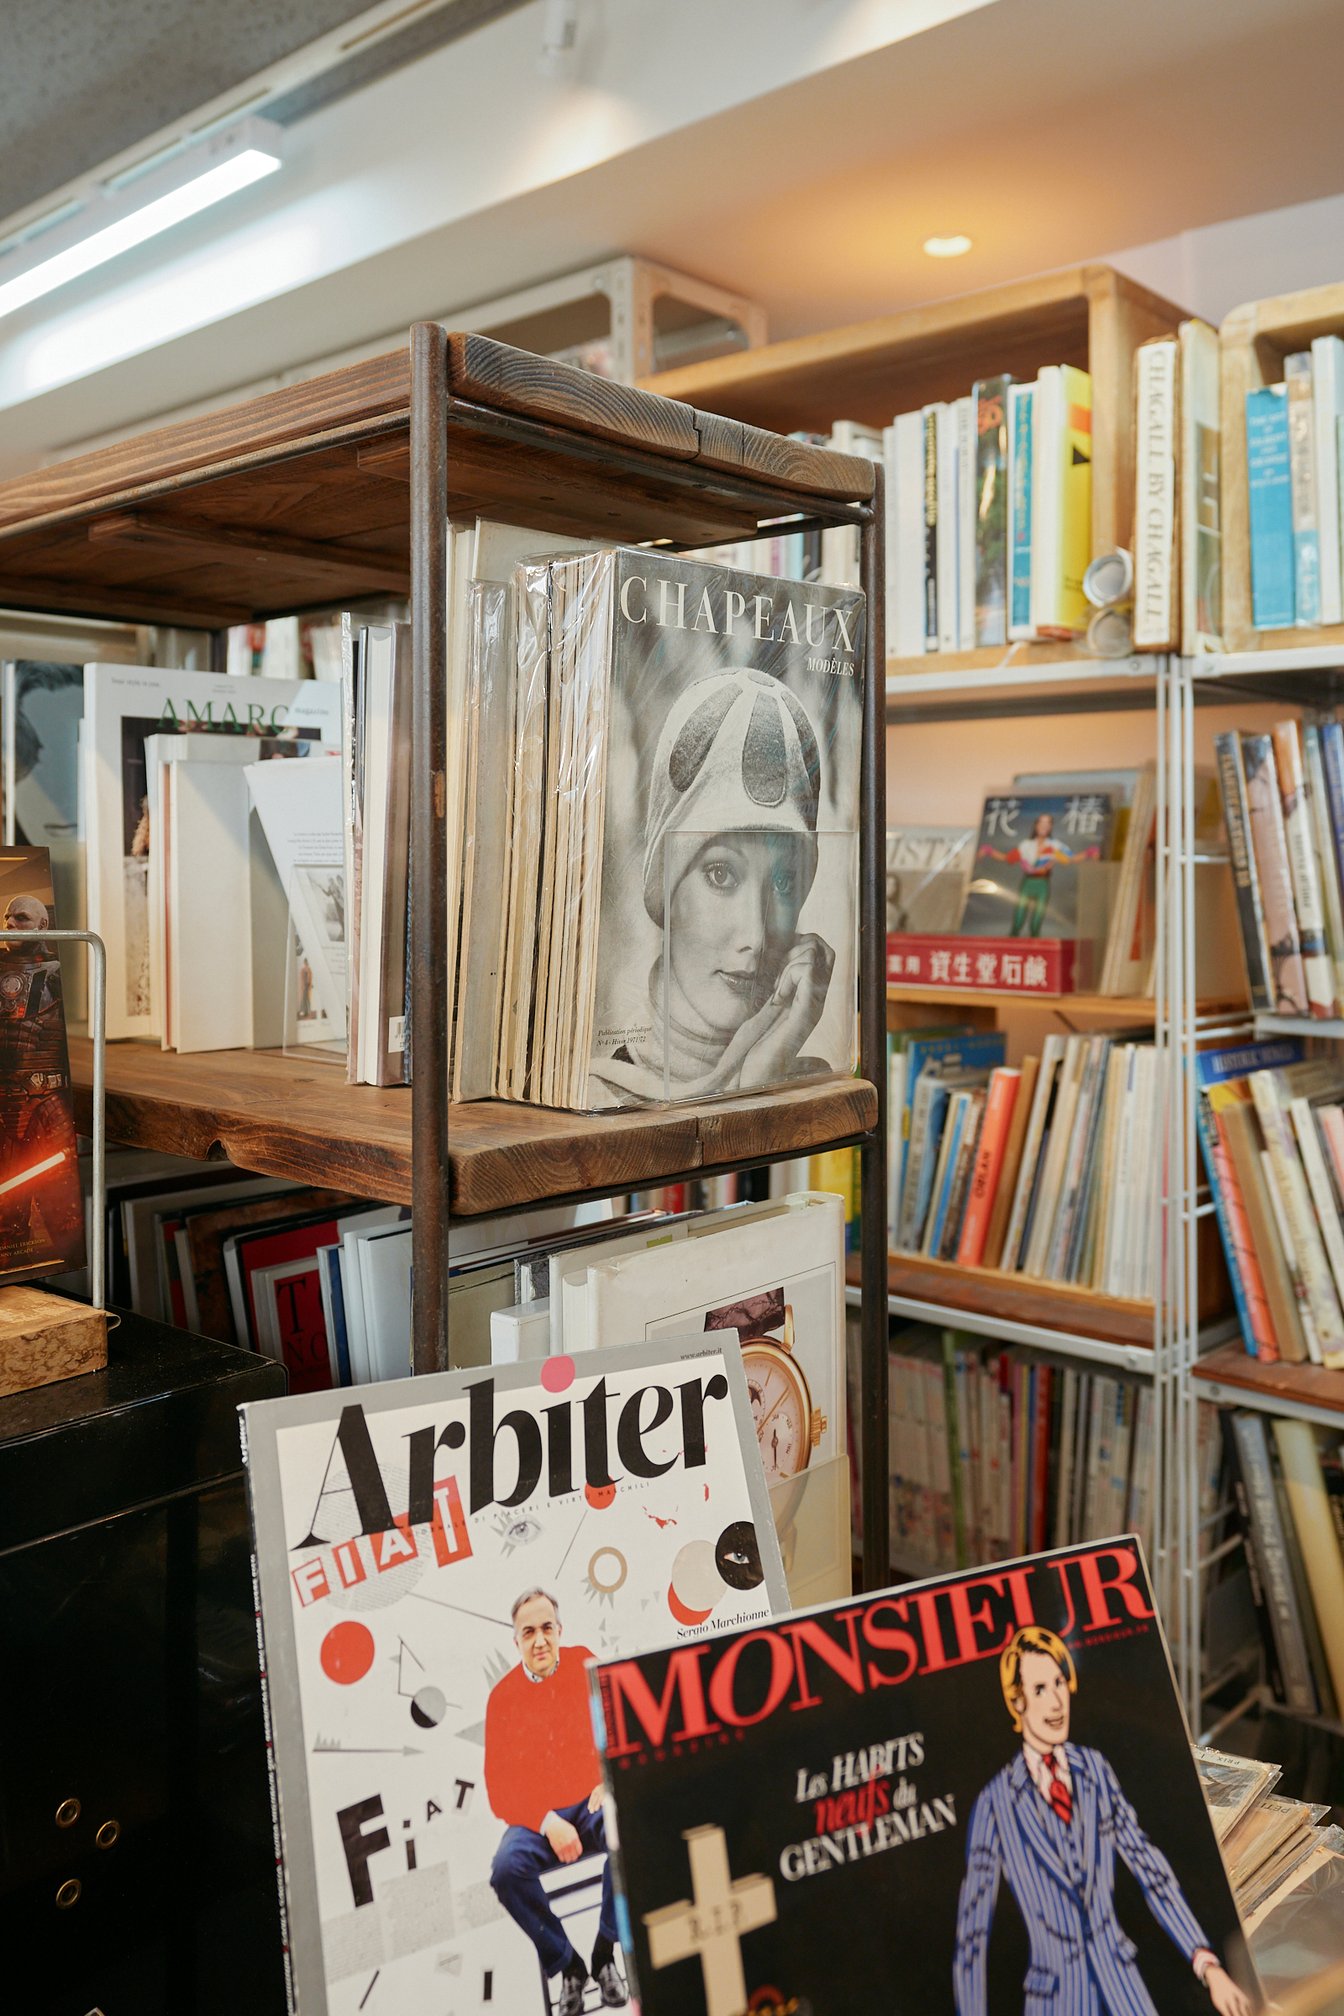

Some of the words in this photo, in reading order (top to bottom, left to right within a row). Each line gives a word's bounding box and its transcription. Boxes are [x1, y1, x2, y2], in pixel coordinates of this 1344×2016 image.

[1147, 350, 1168, 464] CHAGALL
[1147, 472, 1166, 499] BY
[1146, 508, 1166, 622] CHAGALL
[619, 575, 856, 653] CHAPEAUX
[806, 655, 856, 677] MODÈLES
[598, 1028, 626, 1037] Publication
[680, 1347, 722, 1360] www.arbiter.it
[290, 1373, 728, 1551] Arbiter
[294, 1486, 459, 1604] FIAT
[598, 1547, 1156, 1759] MONSIEUR
[676, 1622, 709, 1640] Sergio
[710, 1609, 770, 1632] Marchionne
[831, 1731, 925, 1793] HABITS
[1216, 1757, 1240, 1766] PRIX
[779, 1793, 957, 1882] GENTLEMAN
[813, 1766, 891, 1838] neufs
[893, 1775, 918, 1811] du
